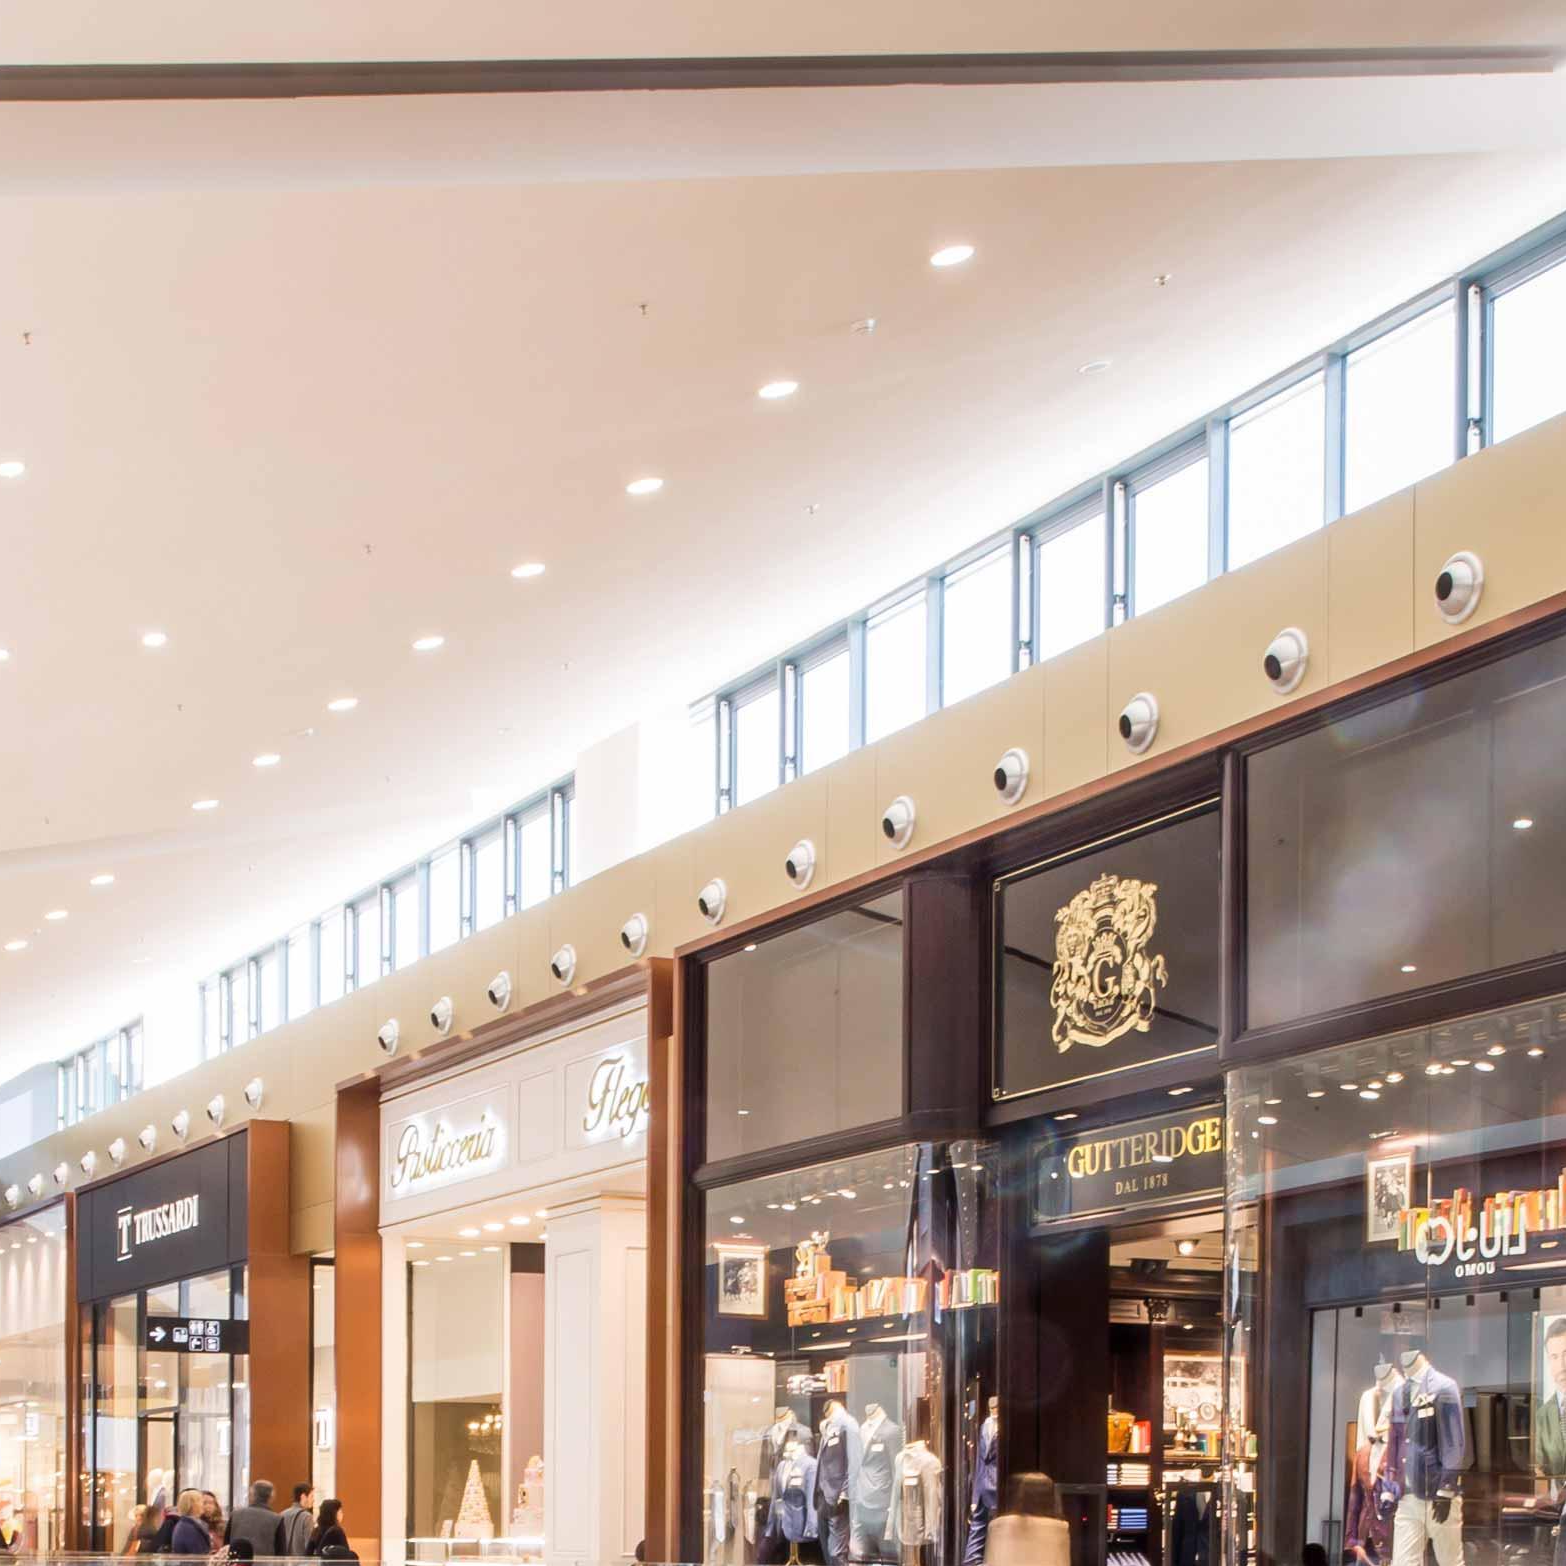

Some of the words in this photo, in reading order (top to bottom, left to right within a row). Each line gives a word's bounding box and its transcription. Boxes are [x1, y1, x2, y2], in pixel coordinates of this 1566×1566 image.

[1093, 957, 1117, 998] G
[1067, 1117, 1223, 1177] GUTTERIDGE
[1115, 1180, 1138, 1195] DAL
[1143, 1173, 1169, 1191] 1878
[133, 1195, 200, 1245] TRUSSARDI
